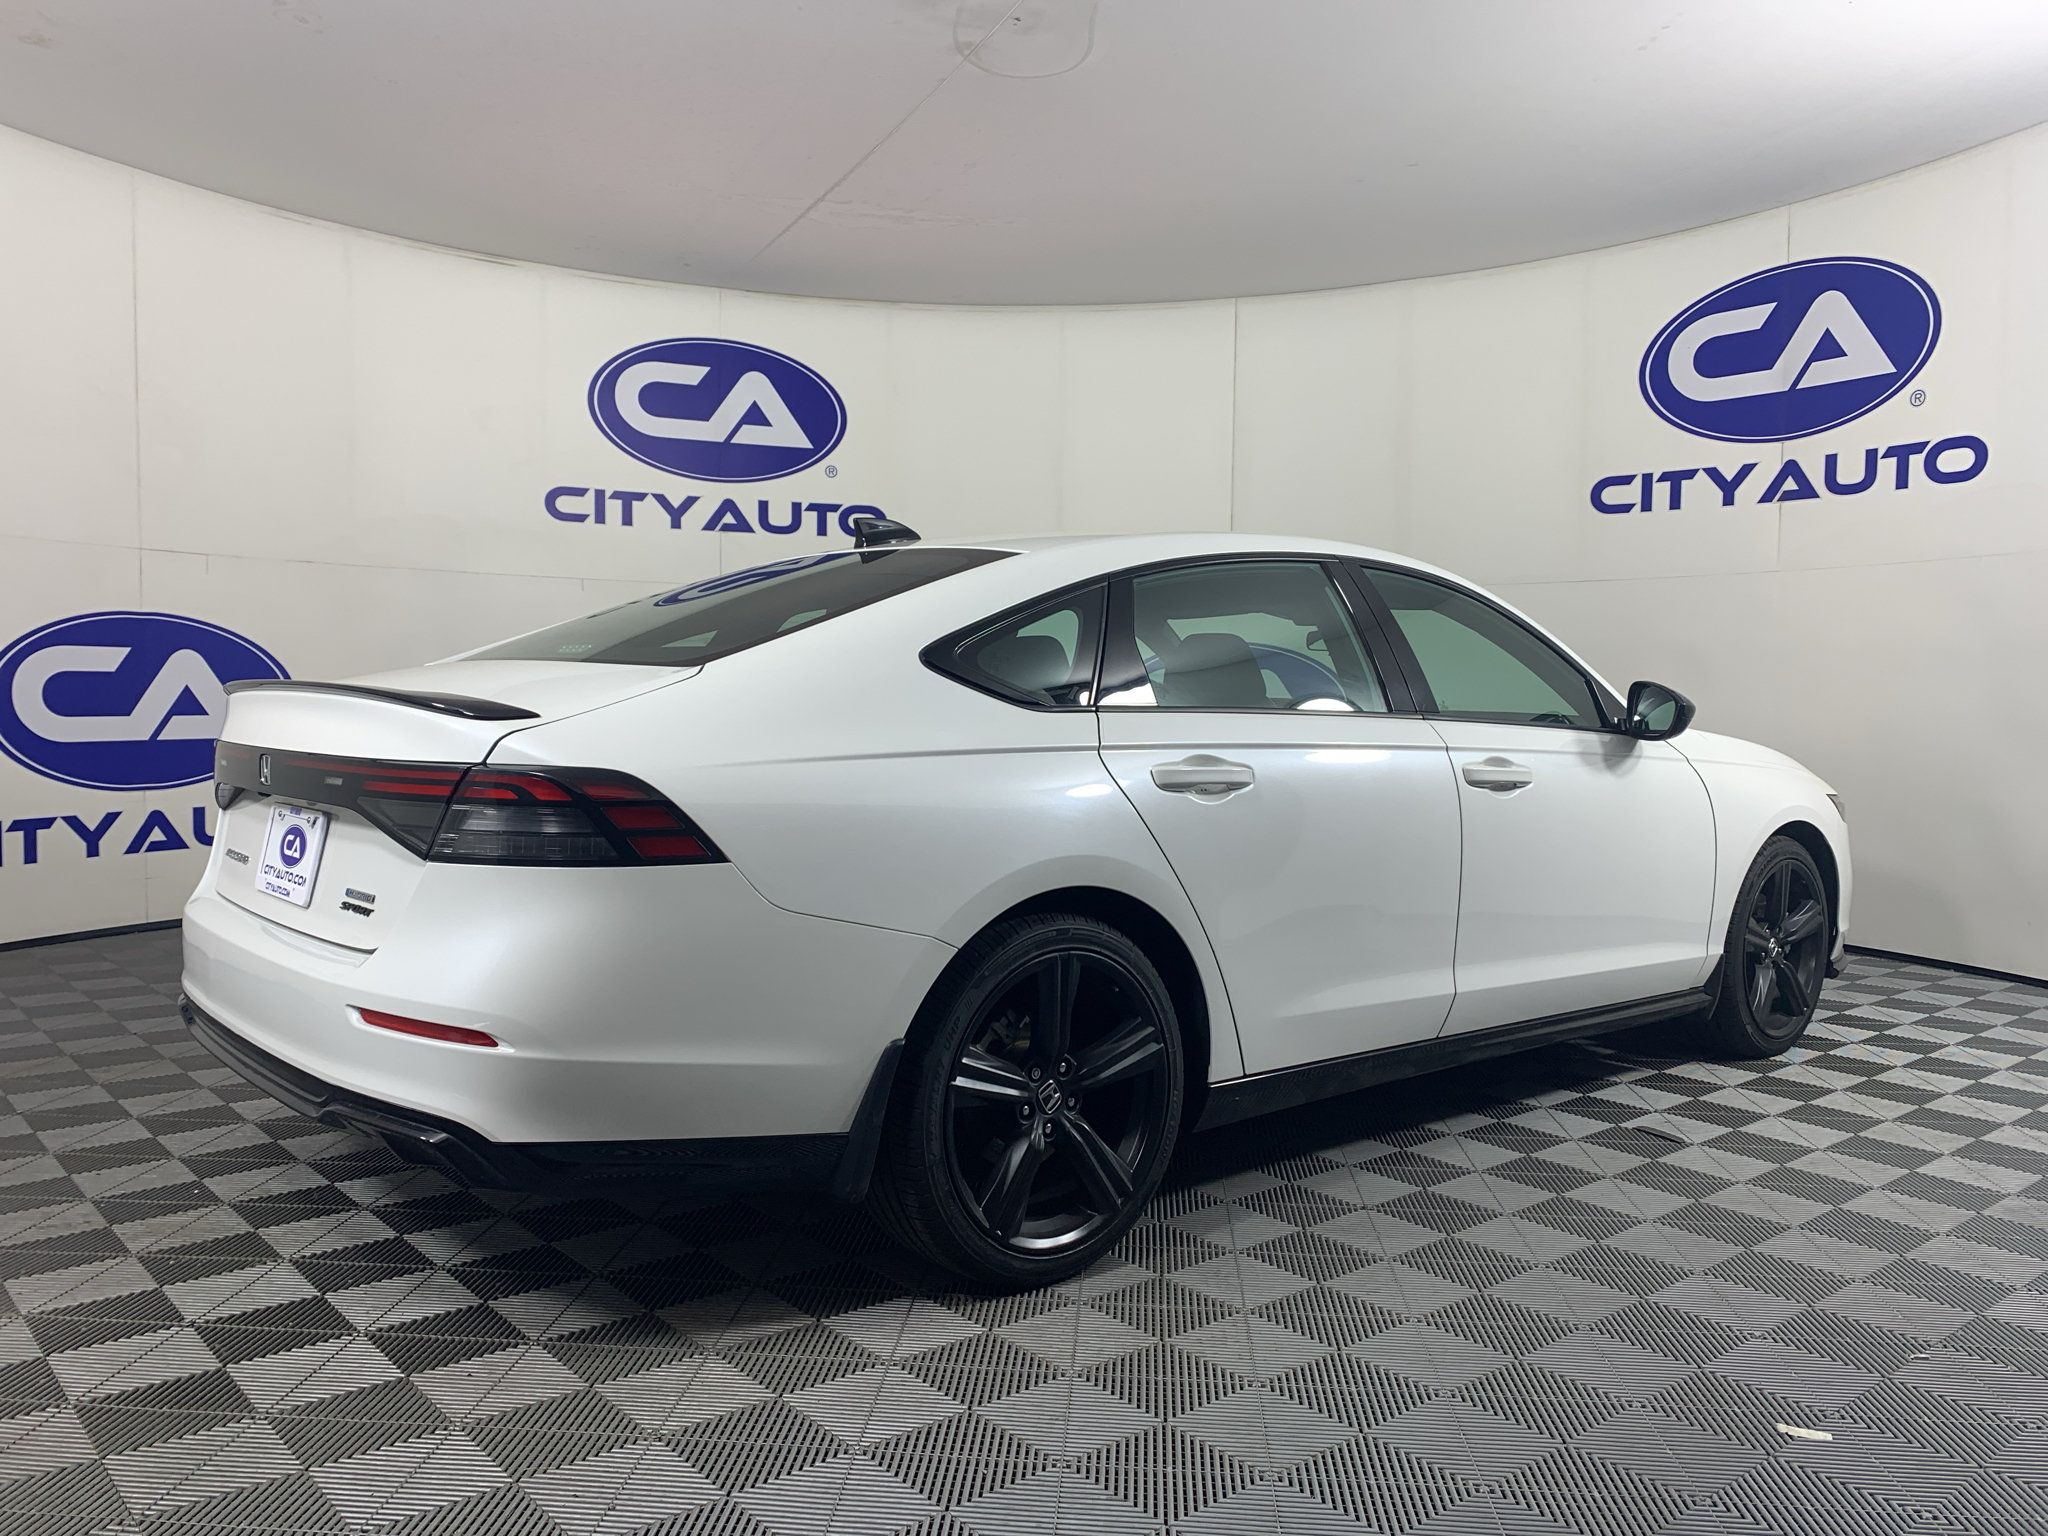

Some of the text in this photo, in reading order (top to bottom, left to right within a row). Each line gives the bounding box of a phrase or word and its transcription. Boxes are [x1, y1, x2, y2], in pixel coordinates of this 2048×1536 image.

[1667, 289, 1898, 402] CA
[614, 361, 815, 449] CA
[11, 644, 229, 743] CA
